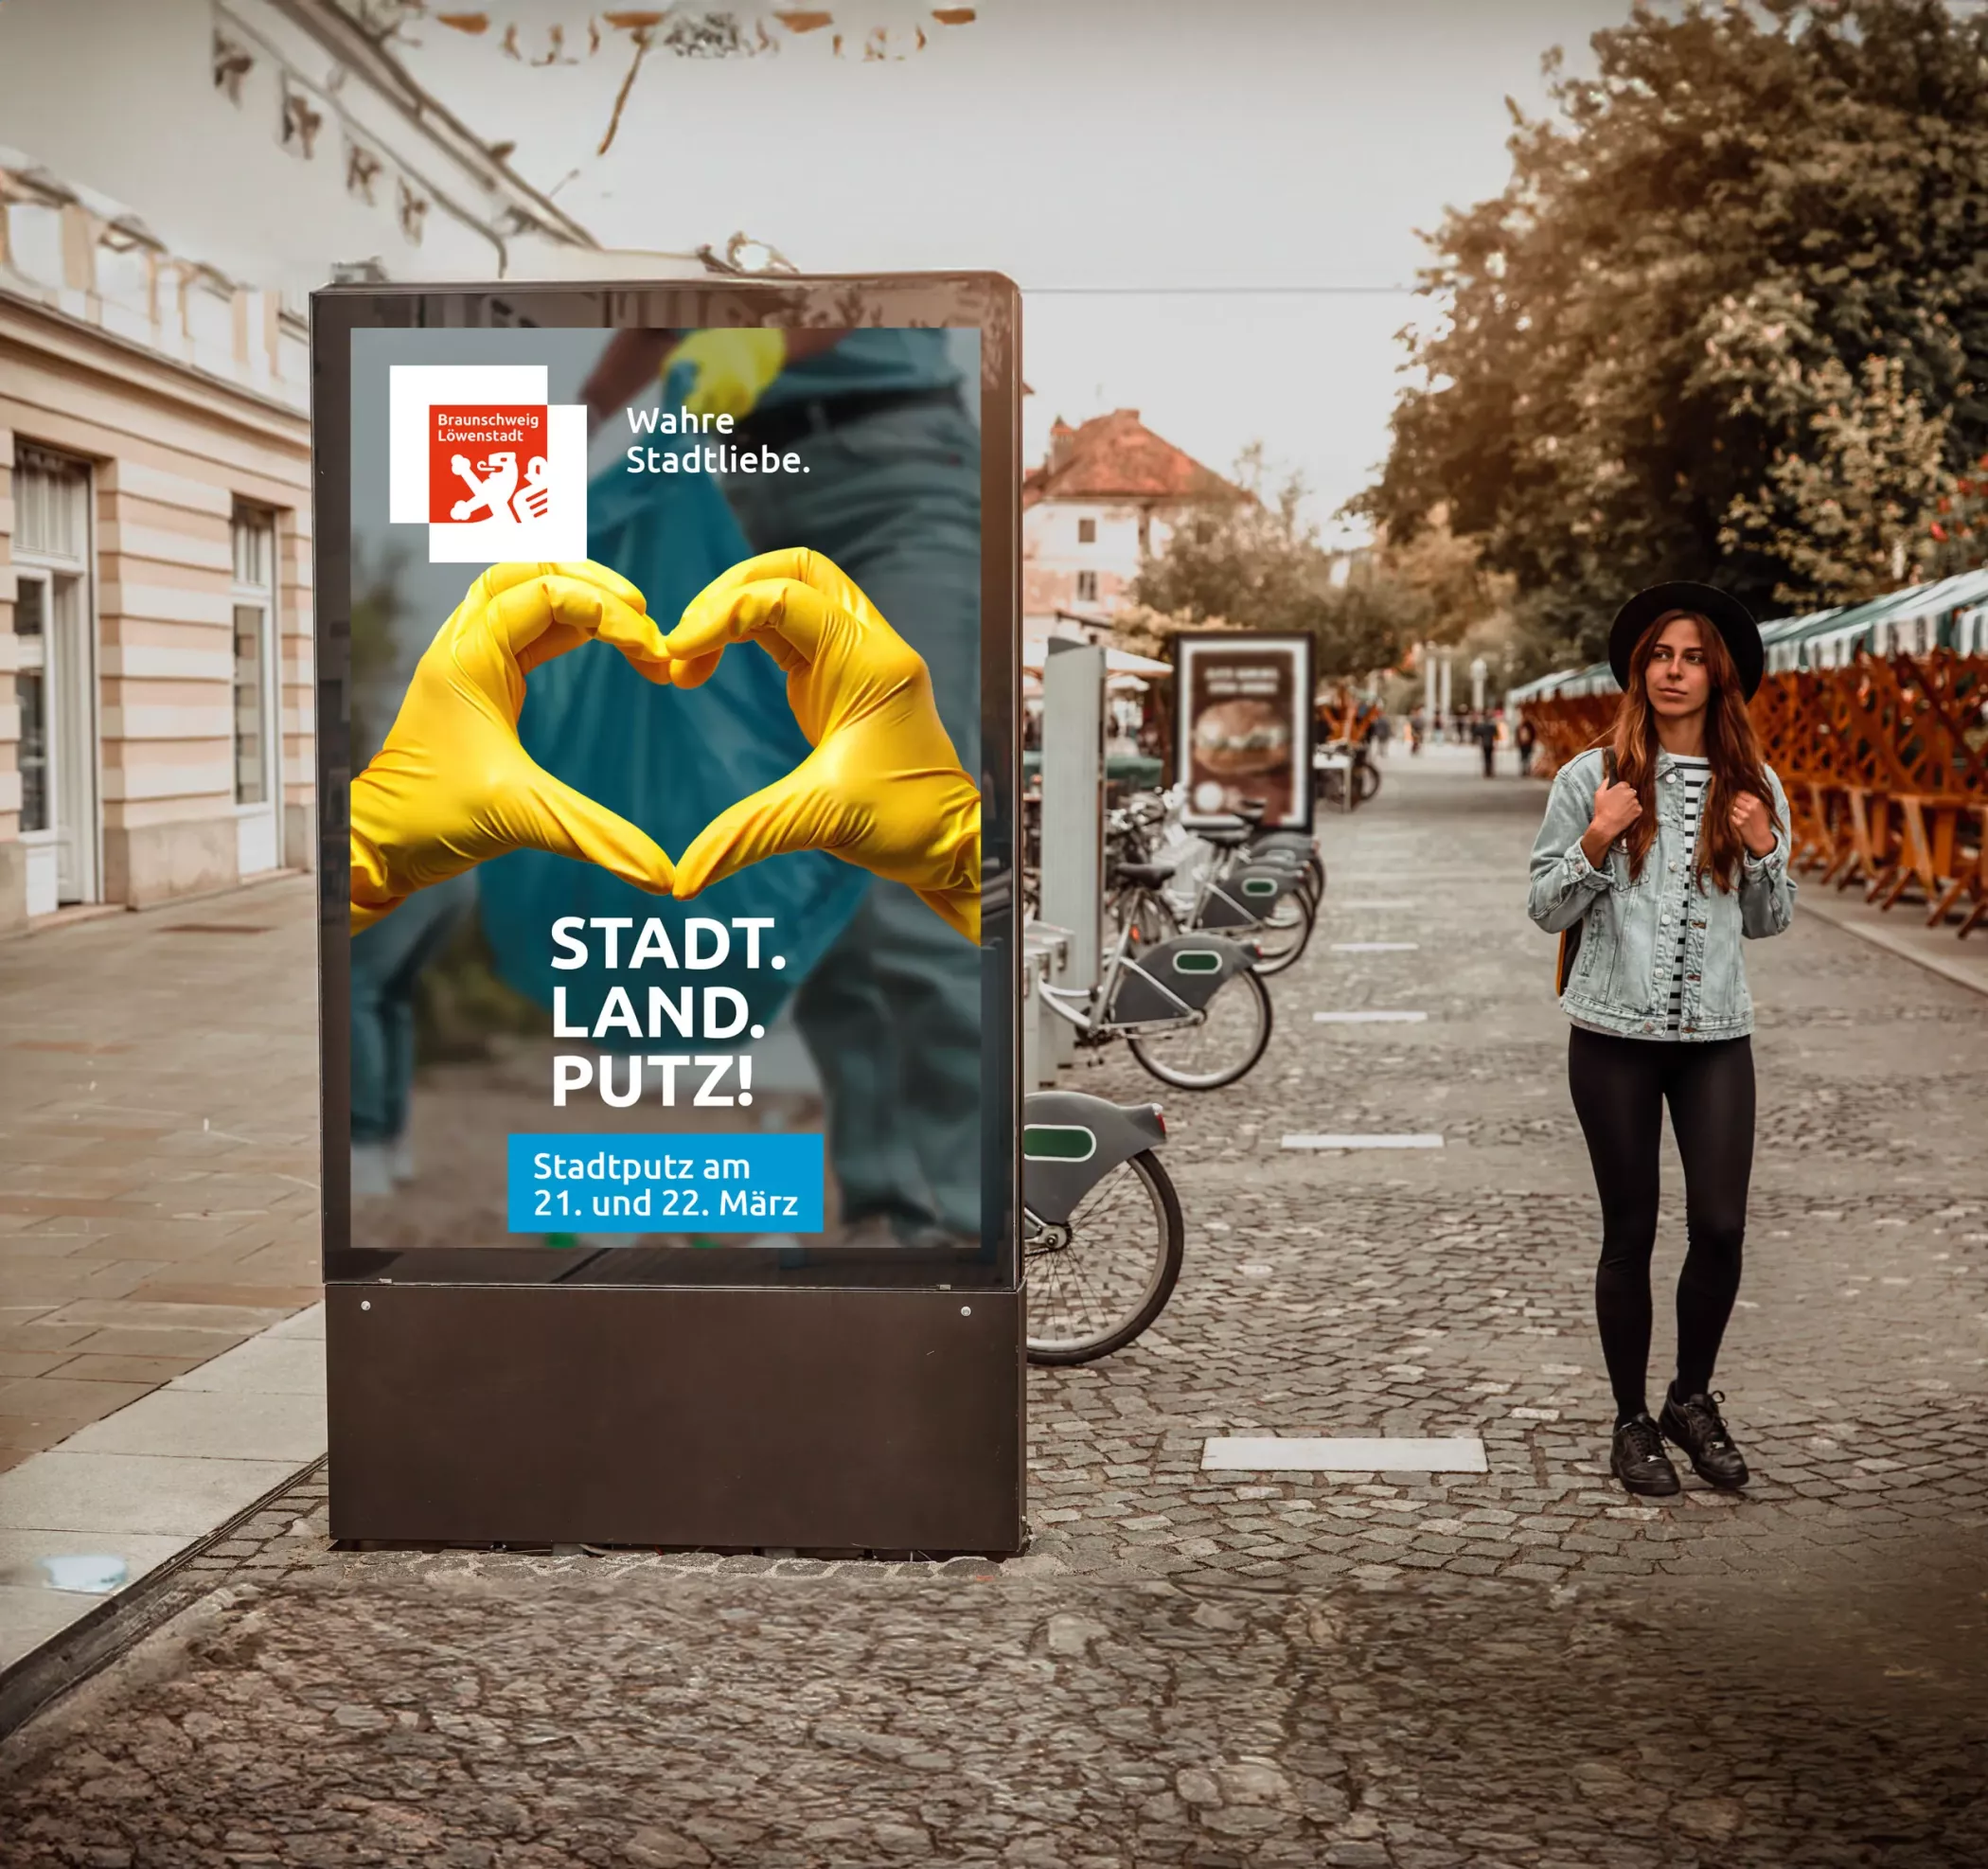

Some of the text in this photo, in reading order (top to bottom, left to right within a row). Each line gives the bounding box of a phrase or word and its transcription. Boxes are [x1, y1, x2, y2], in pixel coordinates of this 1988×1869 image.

[437, 413, 540, 429] Braunschweig
[626, 405, 735, 435] Wahre
[437, 429, 524, 442] Löwenstadt
[626, 445, 809, 473] Stadtliebe.
[550, 917, 786, 970] STADT.
[554, 987, 765, 1039] LAND.
[553, 1055, 753, 1108] PUTZ!
[534, 1151, 751, 1185] Stadtputz am
[534, 1188, 799, 1216] 21. und 22. März
